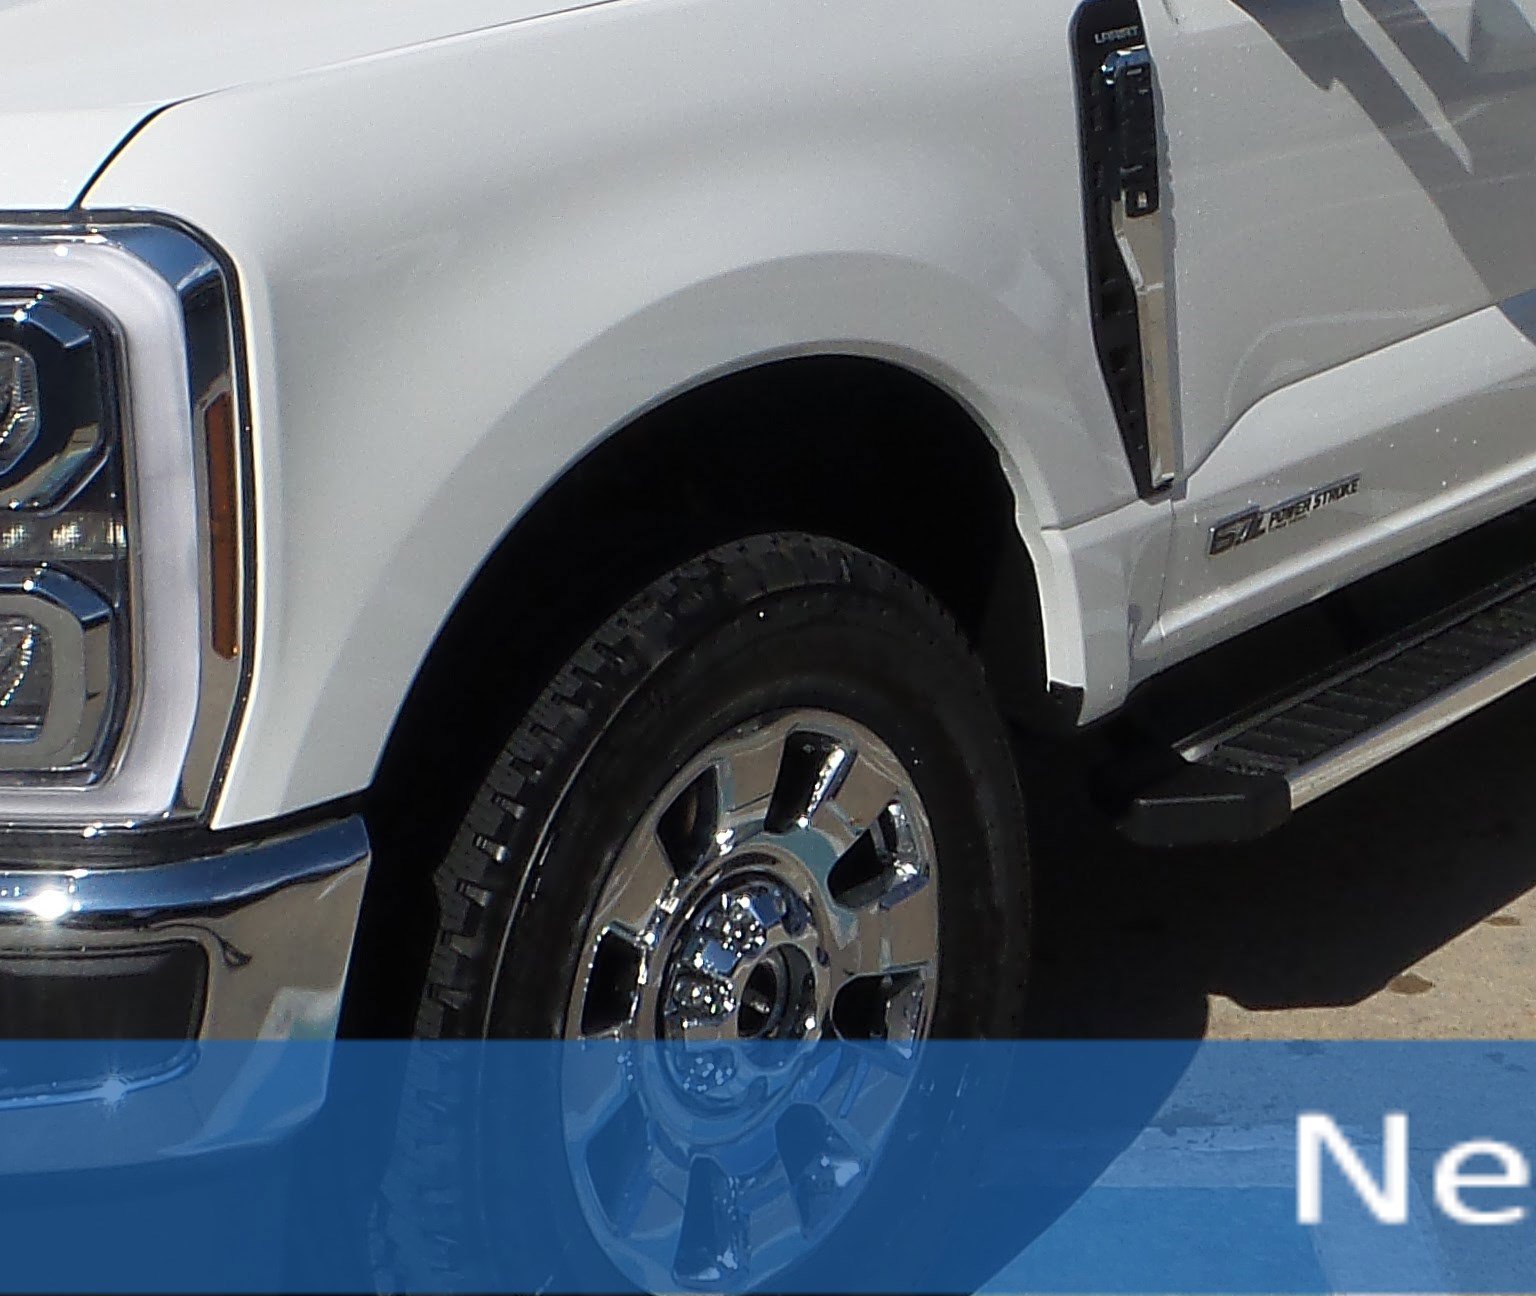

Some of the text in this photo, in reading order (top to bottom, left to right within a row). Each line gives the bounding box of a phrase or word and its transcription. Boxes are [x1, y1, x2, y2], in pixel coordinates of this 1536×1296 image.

[1208, 508, 1266, 555] 6.7L
[1268, 498, 1313, 524] POWER
[1313, 478, 1360, 510] STROKE
